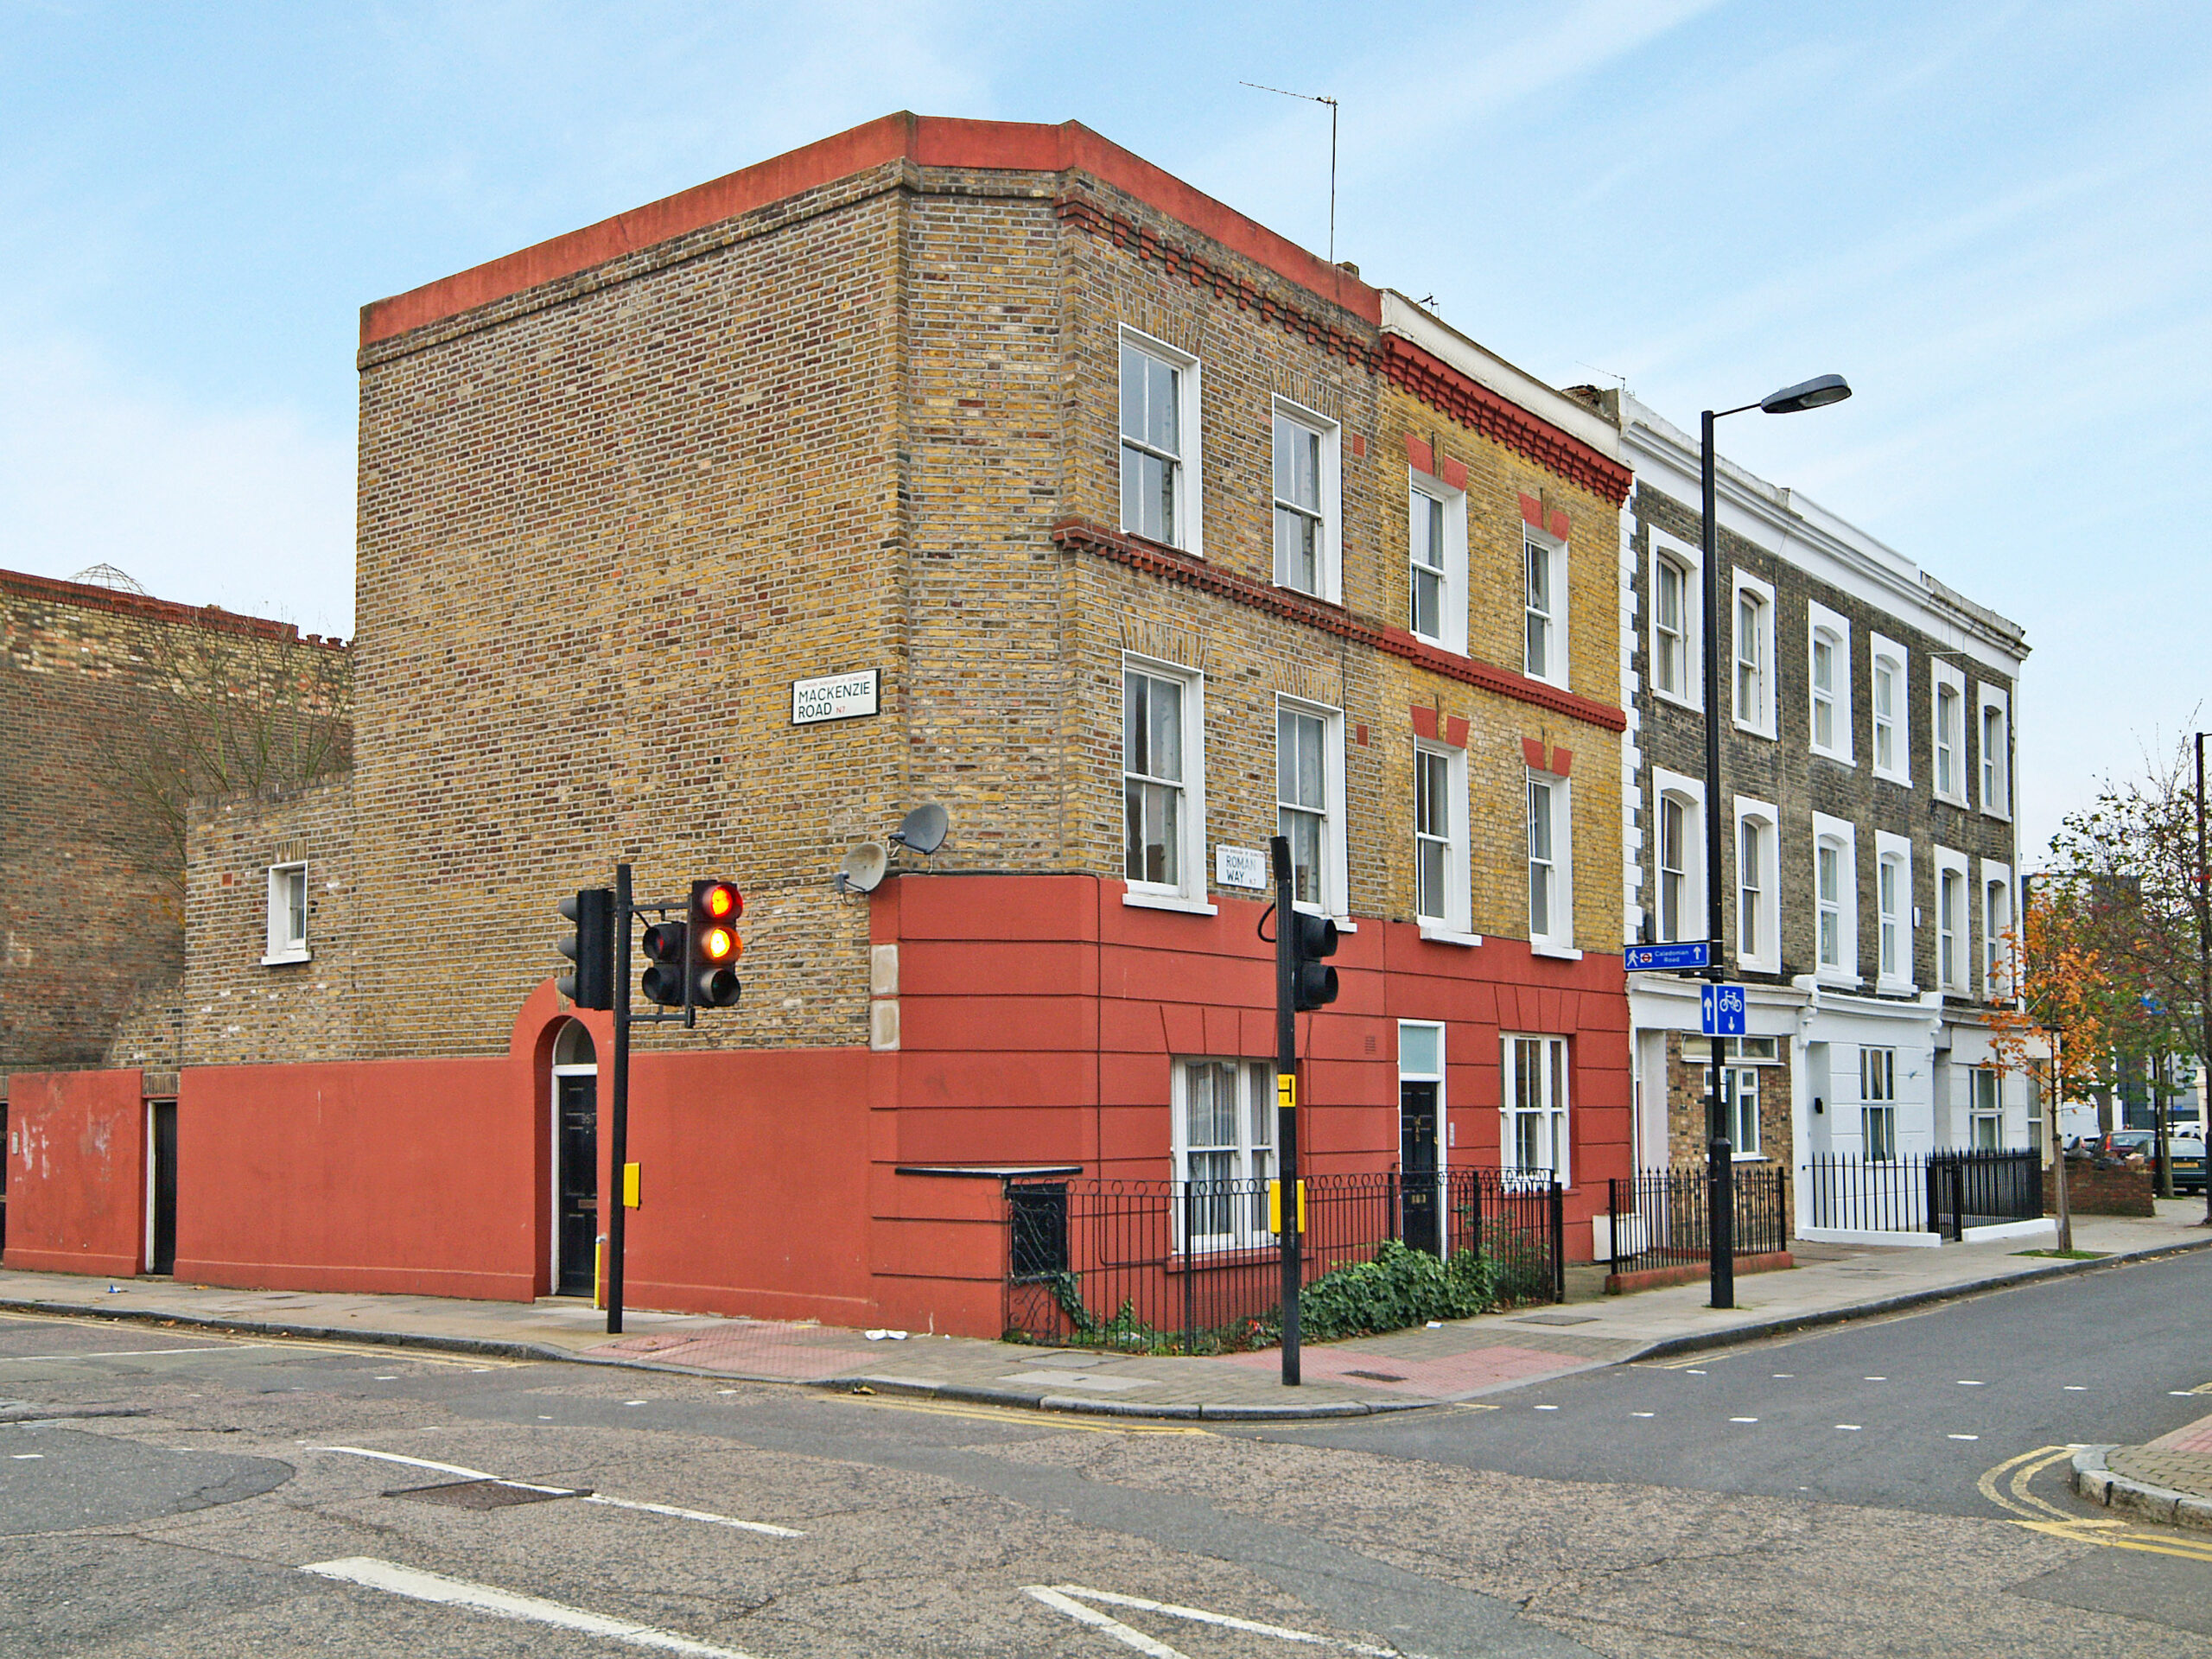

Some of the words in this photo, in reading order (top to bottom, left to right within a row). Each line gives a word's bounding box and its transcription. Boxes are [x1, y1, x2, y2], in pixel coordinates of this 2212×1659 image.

[798, 681, 871, 703] MACKENZIE
[798, 702, 832, 719] ROAD
[1226, 855, 1256, 871] ROMAN
[1226, 869, 1244, 884] WAY
